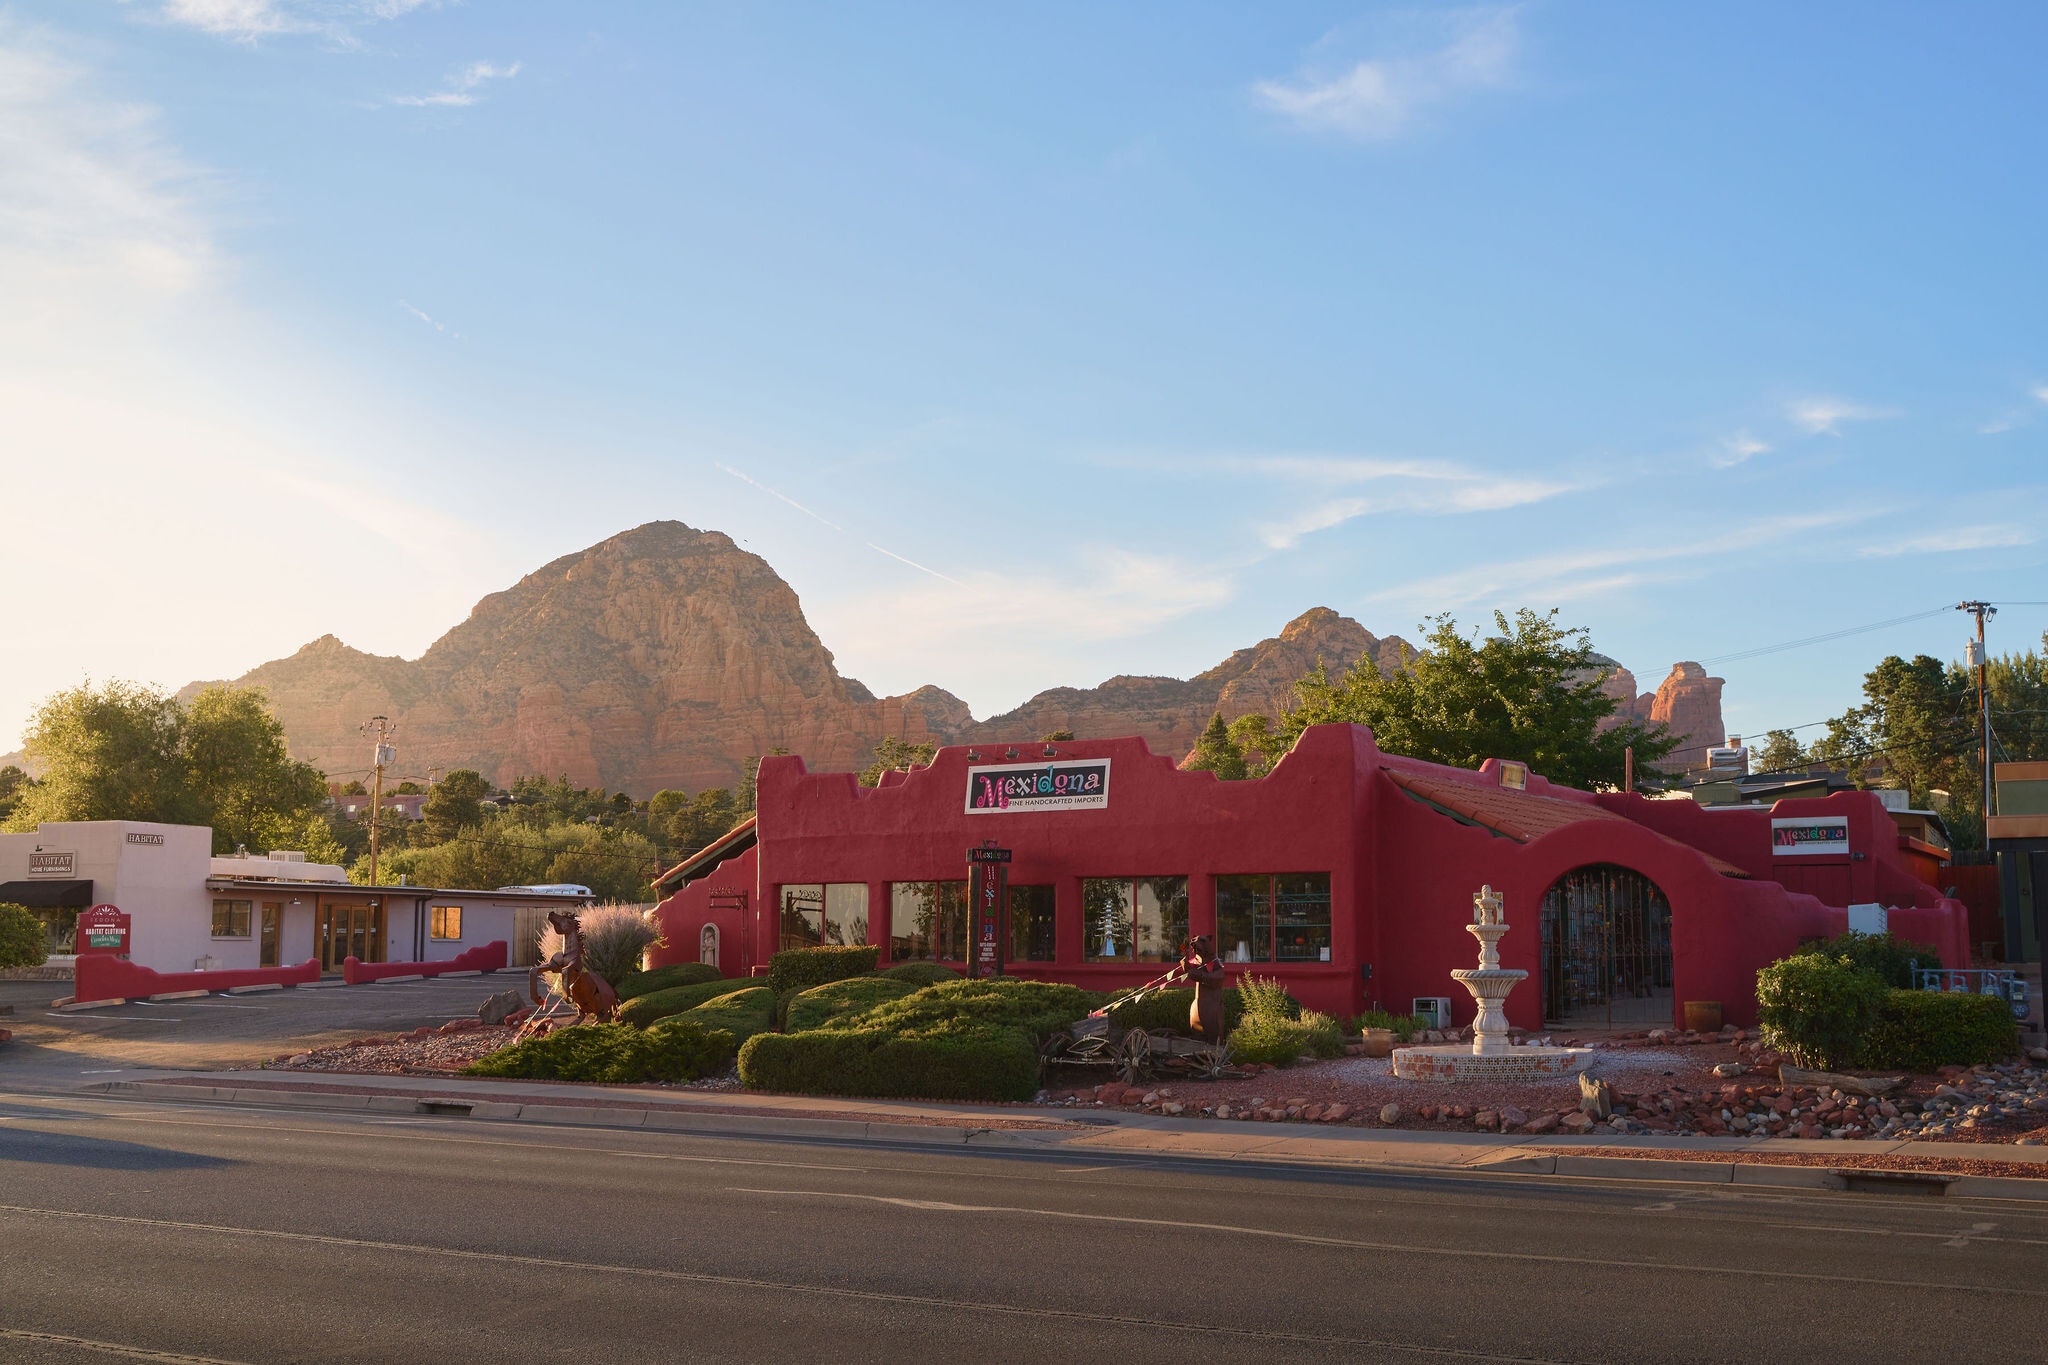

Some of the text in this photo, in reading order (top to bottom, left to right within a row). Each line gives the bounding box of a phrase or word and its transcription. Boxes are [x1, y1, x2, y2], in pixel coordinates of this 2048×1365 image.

[976, 765, 1100, 809] Mexidona
[1025, 798, 1073, 806] HANDCRAFTED
[1074, 796, 1104, 804] IMPORTS
[128, 834, 164, 844] HABITAT
[1777, 824, 1844, 846] Mexidona
[973, 850, 1010, 860] Mexidoa
[32, 856, 71, 866] HABITAT
